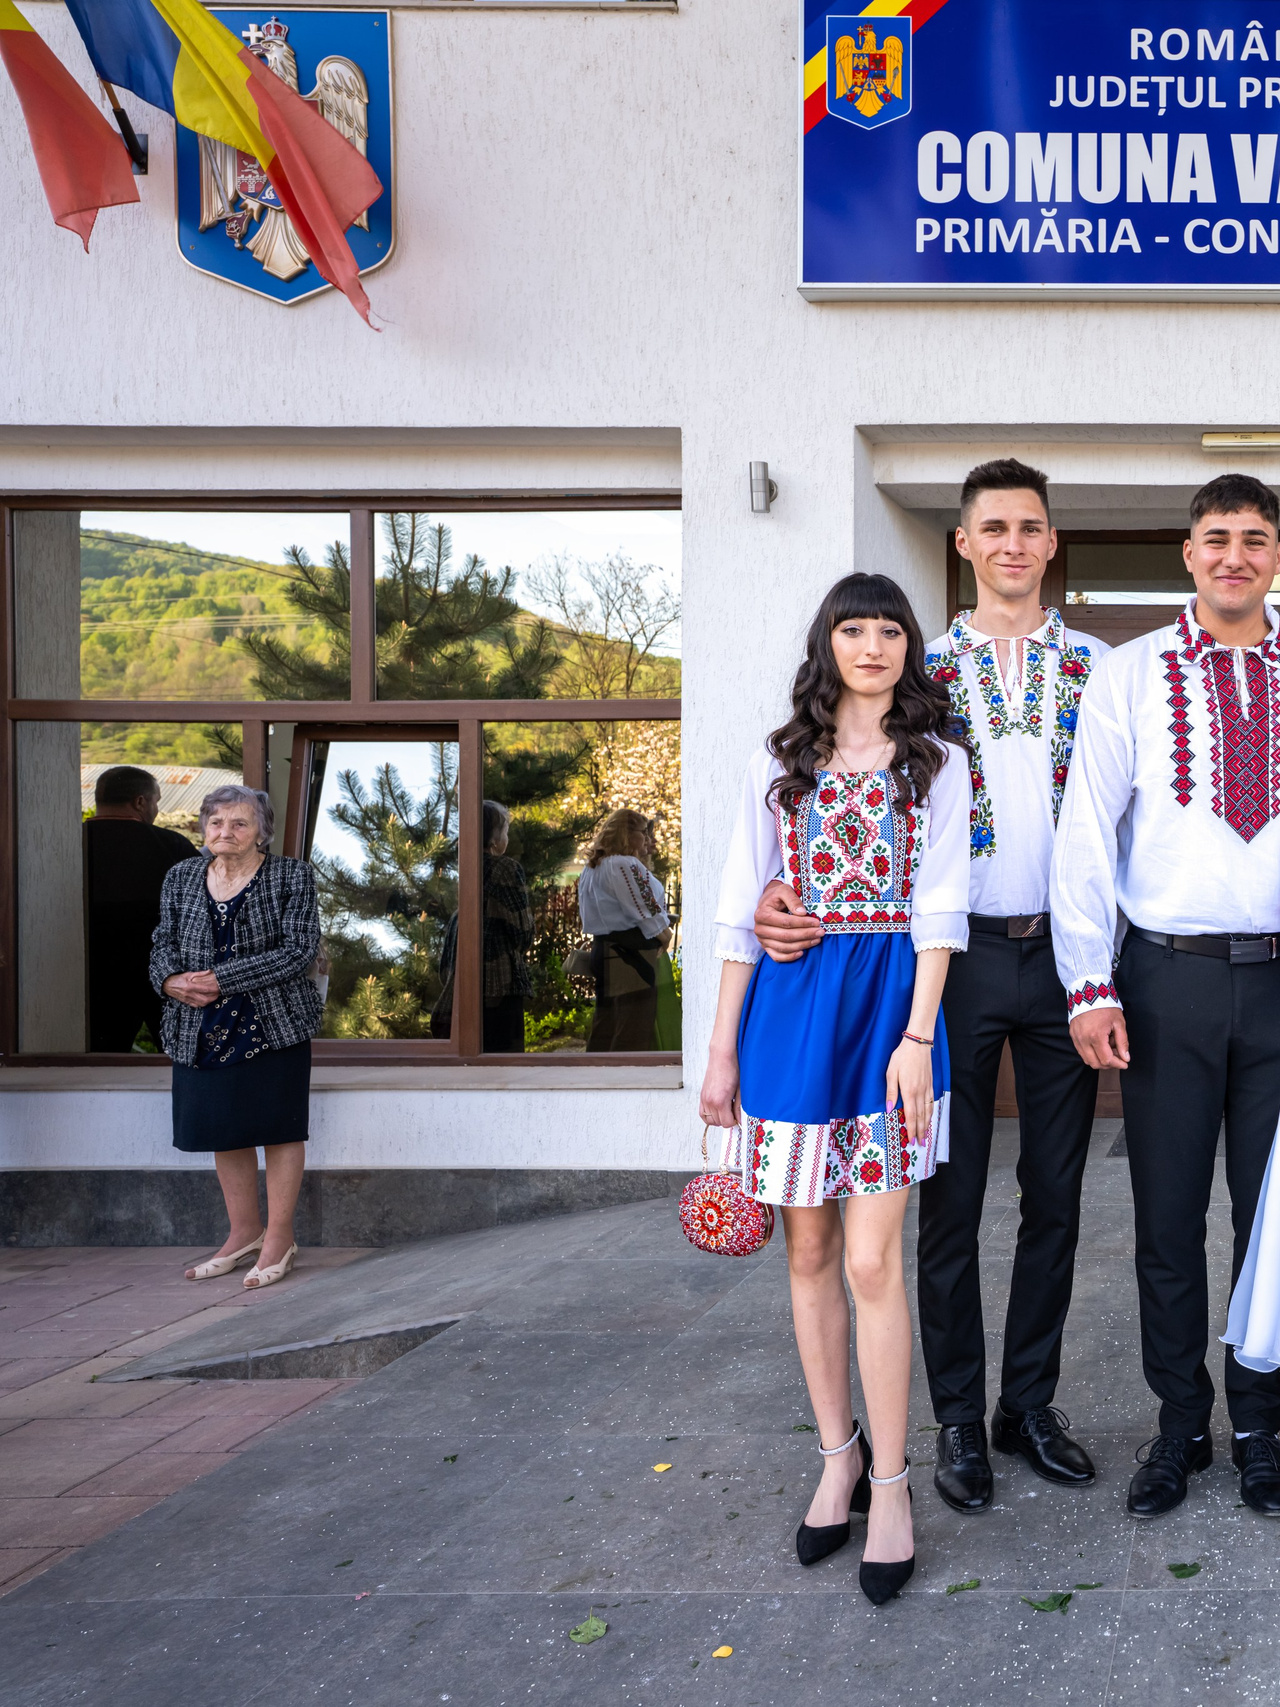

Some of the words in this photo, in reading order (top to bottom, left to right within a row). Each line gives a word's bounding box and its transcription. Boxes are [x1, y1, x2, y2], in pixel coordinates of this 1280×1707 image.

[1049, 75, 1227, 116] JUDEȚUL
[917, 130, 1217, 204] COMUNA
[915, 207, 1142, 254] PRIMĂRIA
